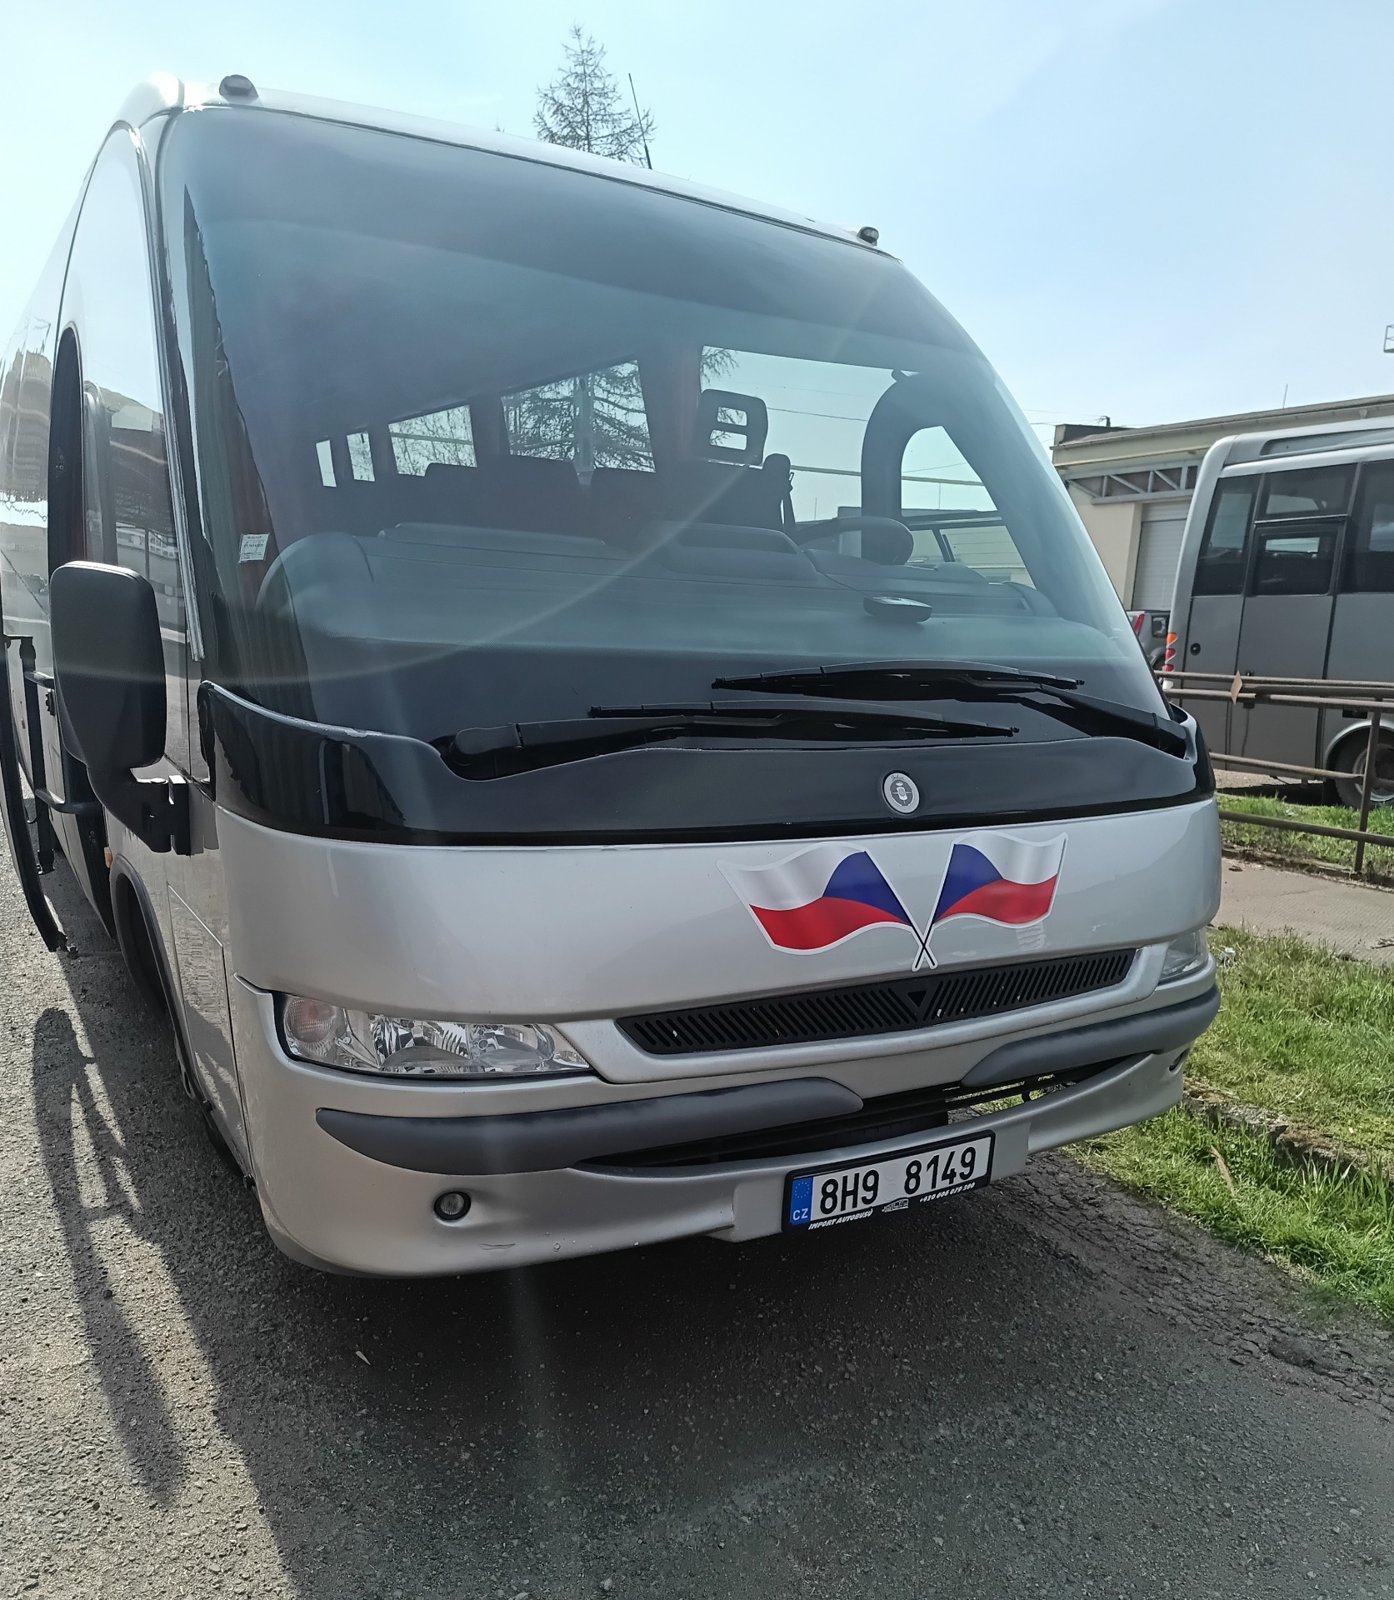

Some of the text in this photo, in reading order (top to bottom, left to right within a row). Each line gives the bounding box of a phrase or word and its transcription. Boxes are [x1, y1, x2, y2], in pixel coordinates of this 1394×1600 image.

[819, 1146, 976, 1215] 8H9 8149
[792, 1207, 809, 1221] CZ
[807, 1218, 837, 1231] IMPORT
